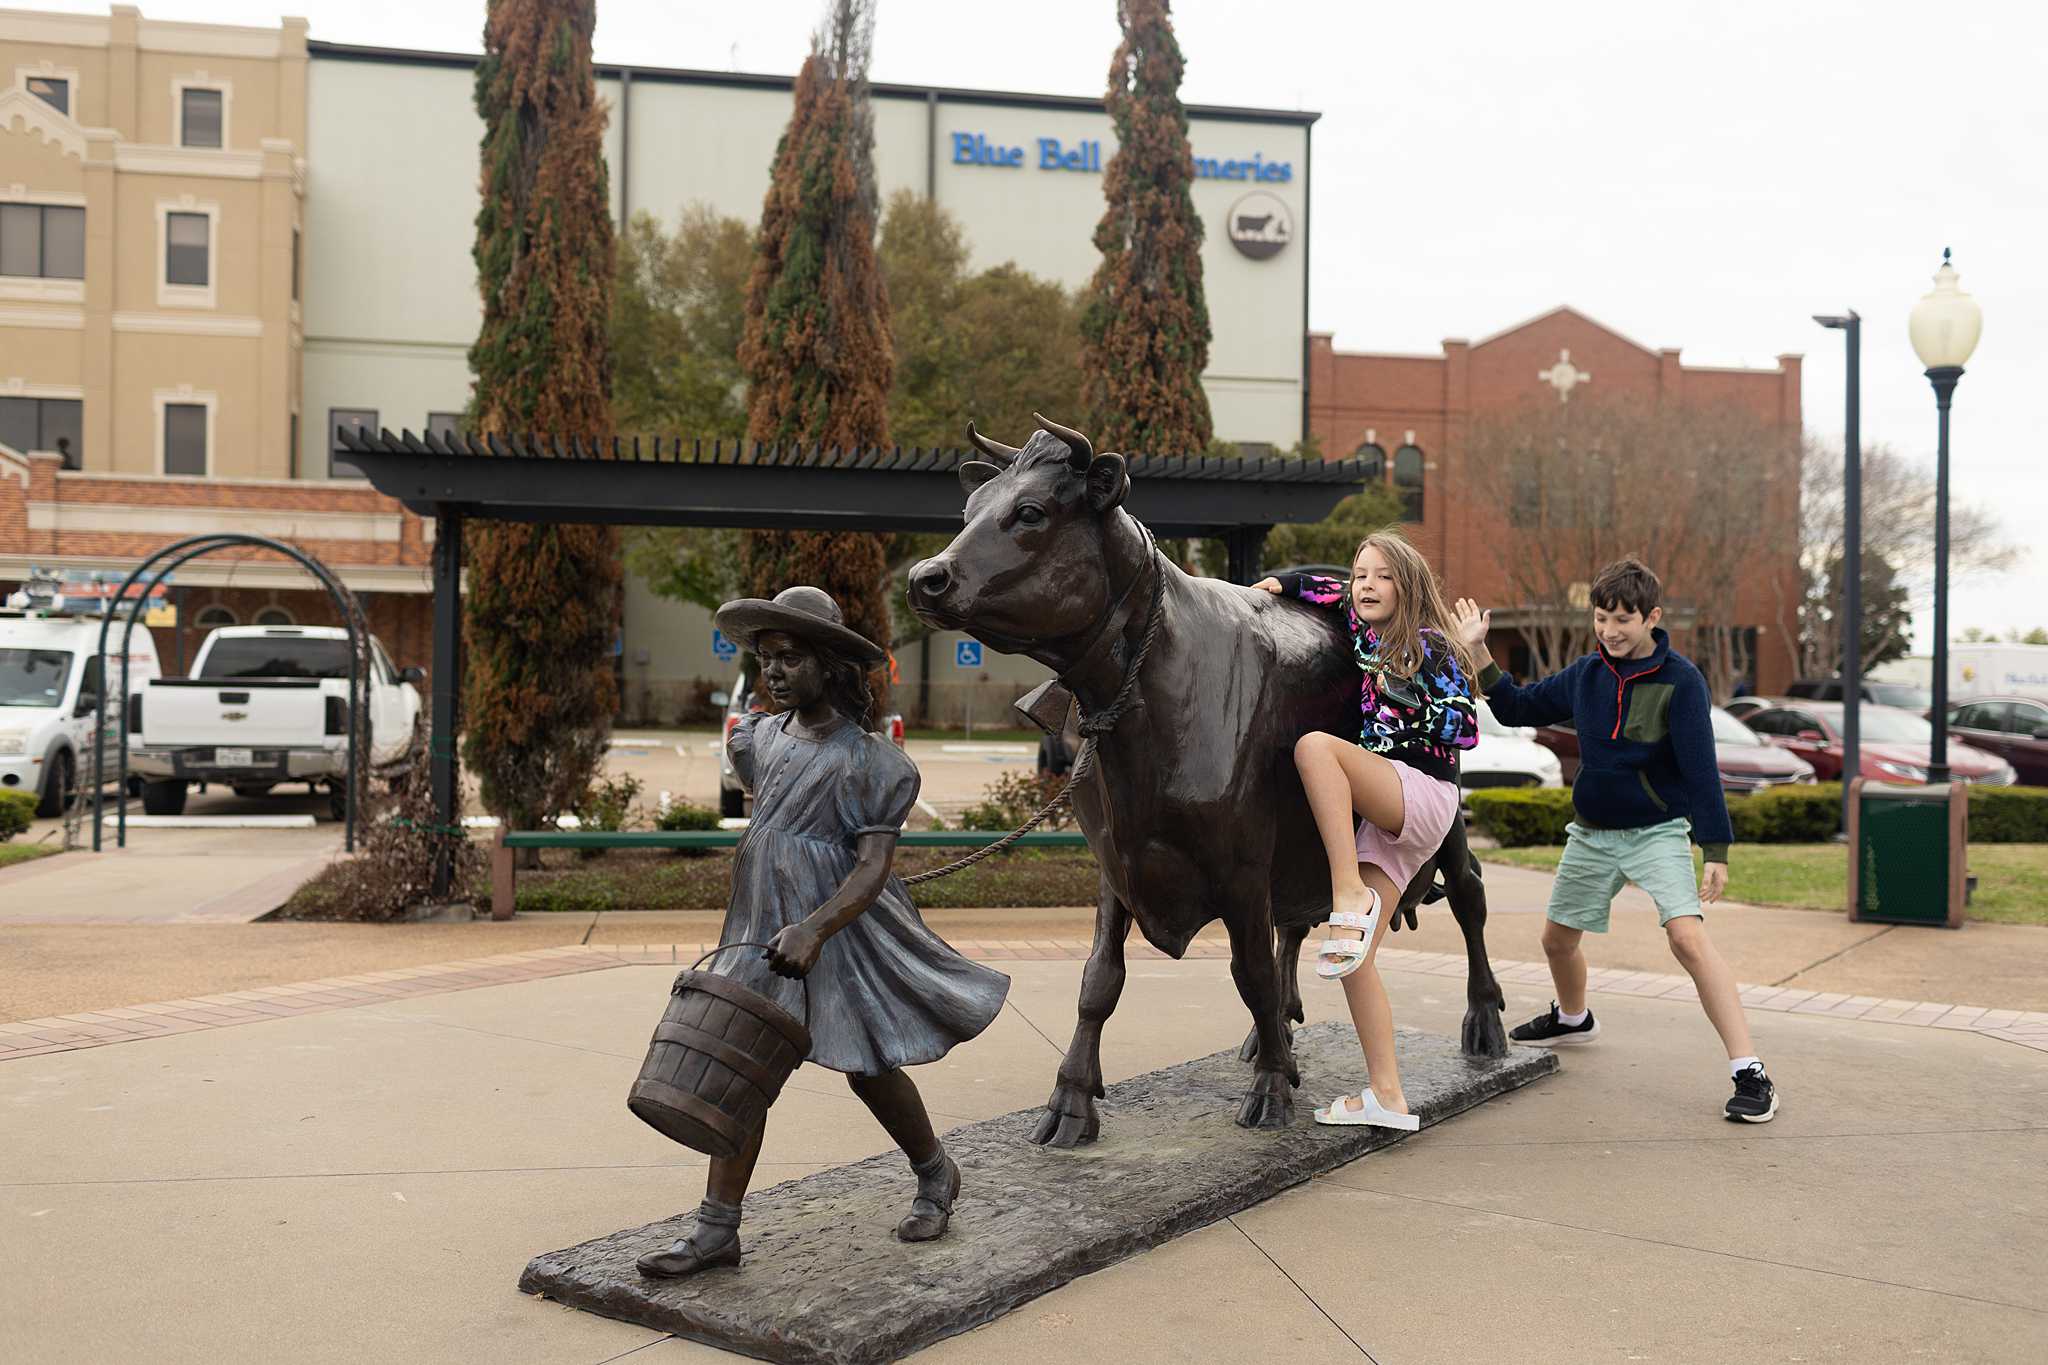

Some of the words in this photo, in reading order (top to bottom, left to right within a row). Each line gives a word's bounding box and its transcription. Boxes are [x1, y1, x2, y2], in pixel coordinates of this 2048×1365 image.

[951, 131, 1024, 166] Blue
[1037, 137, 1101, 172] Bell
[1191, 152, 1293, 183] meries
